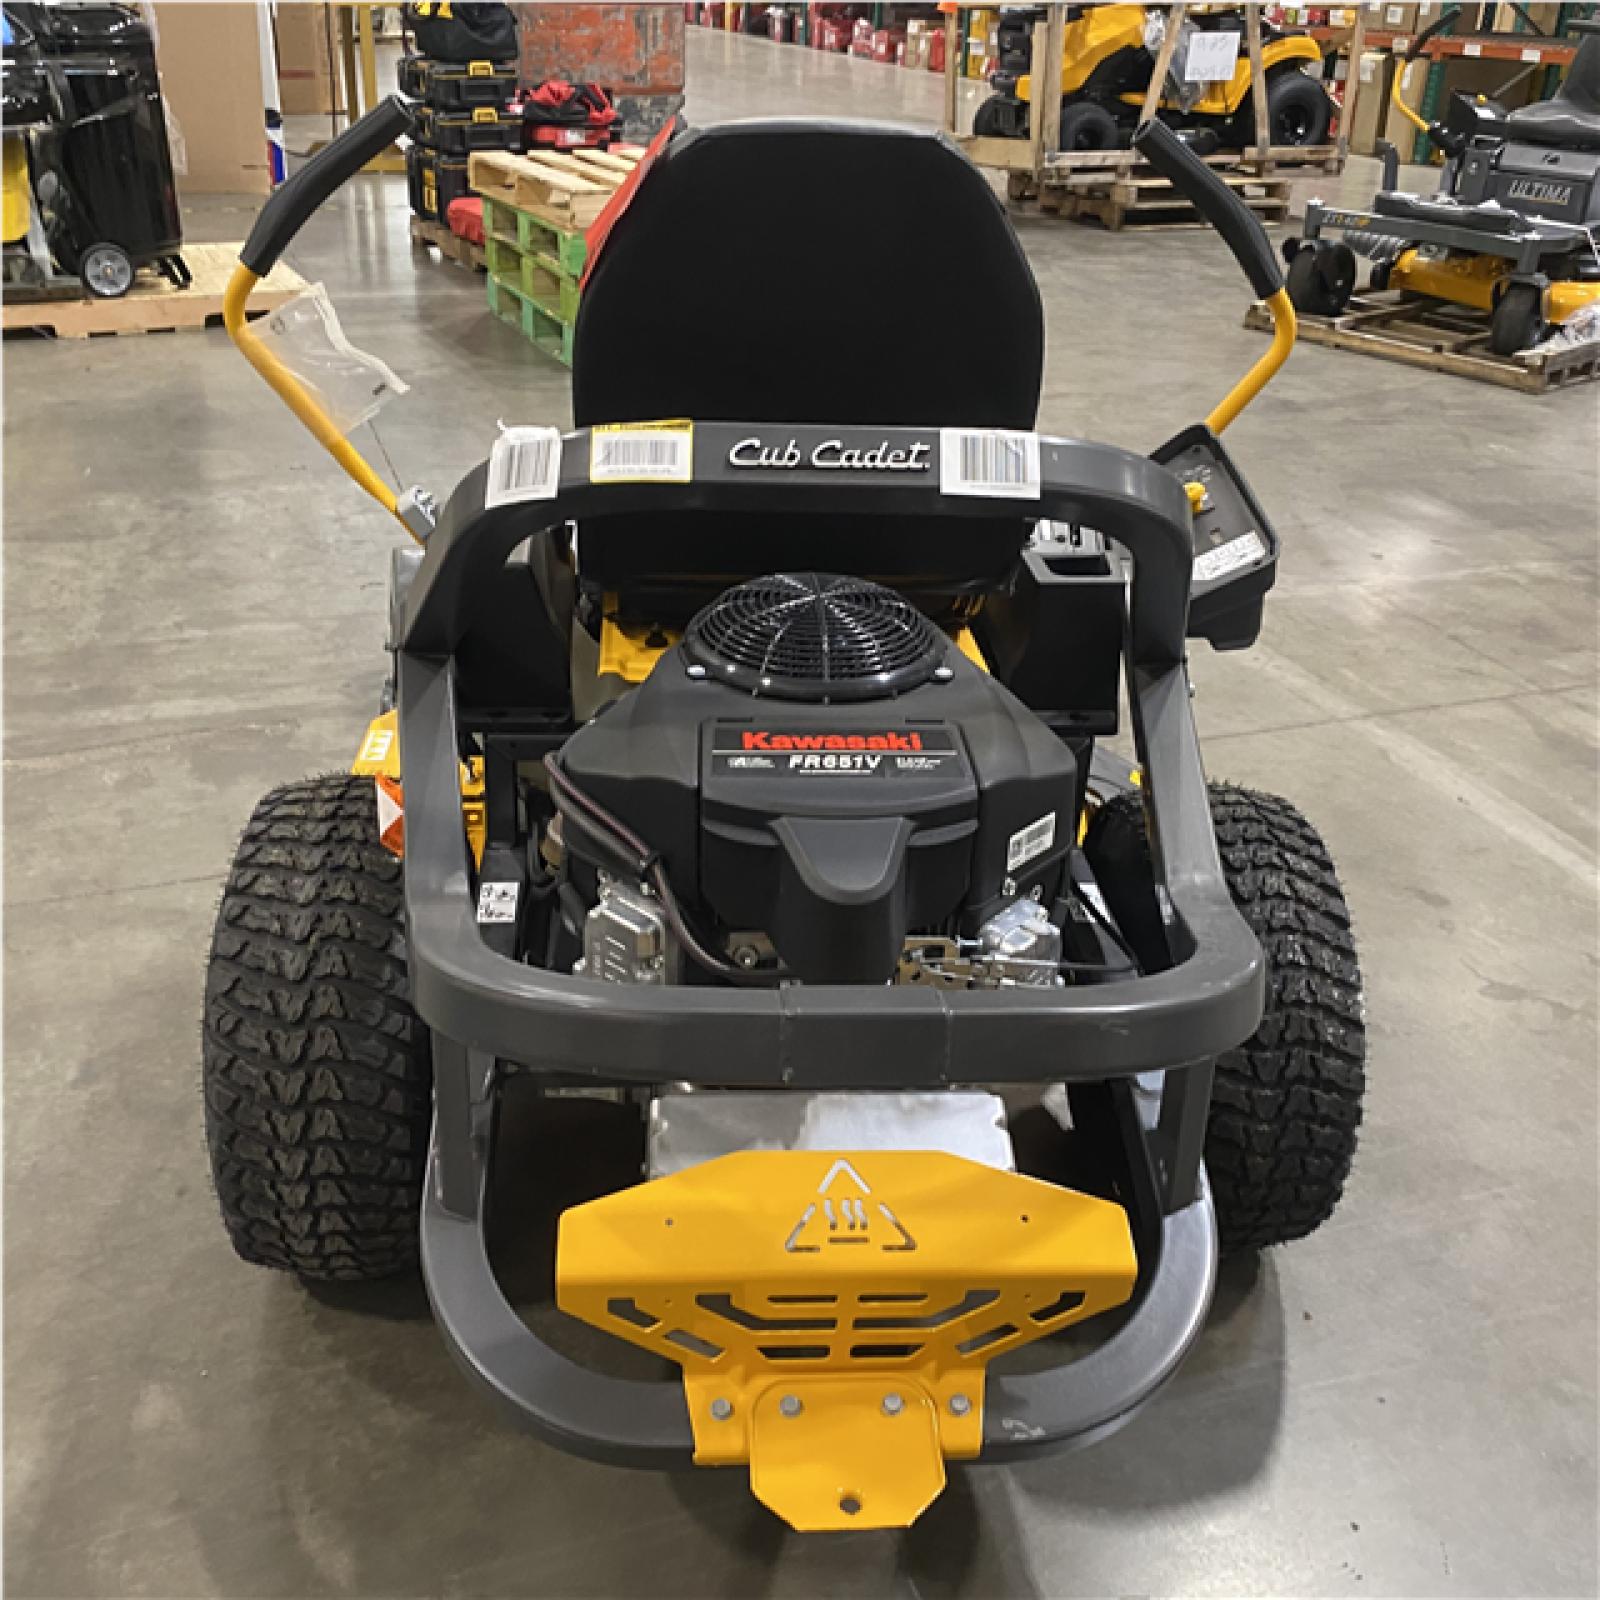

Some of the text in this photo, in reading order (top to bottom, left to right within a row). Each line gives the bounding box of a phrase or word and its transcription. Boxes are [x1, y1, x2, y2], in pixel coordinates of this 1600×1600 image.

[1507, 179, 1571, 202] ULTIMA
[729, 438, 801, 467] Cub
[741, 731, 923, 751] Kawasaki
